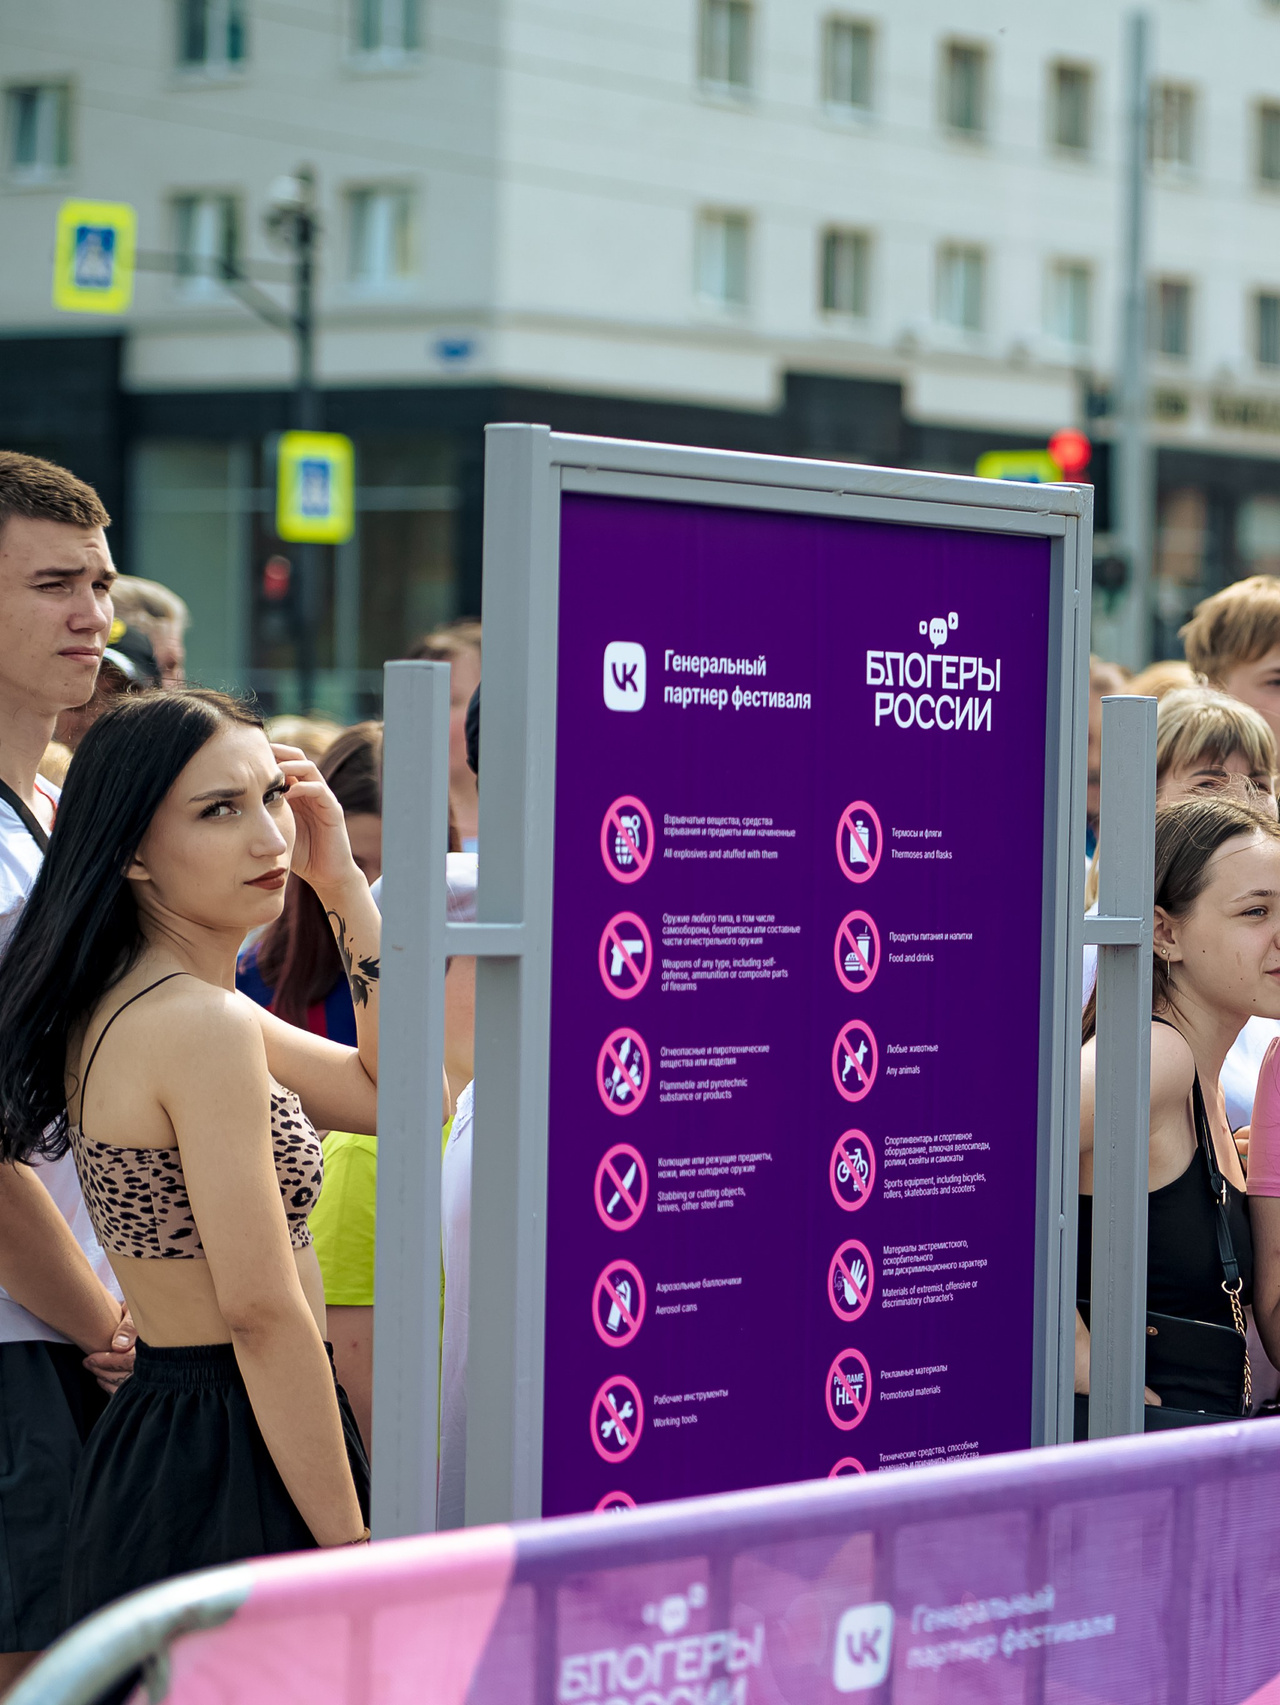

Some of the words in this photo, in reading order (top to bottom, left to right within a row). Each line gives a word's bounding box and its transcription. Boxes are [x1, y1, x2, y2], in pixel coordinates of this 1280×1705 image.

[664, 649, 767, 678] Генеральный
[867, 650, 1001, 692] БЛОГЕРЫ
[664, 685, 727, 710] партнер
[732, 686, 811, 711] фестиваля
[874, 692, 991, 731] РОССИИ
[664, 814, 705, 825] Взрывчатые
[742, 817, 772, 826] средства
[708, 828, 741, 838] предметы
[892, 827, 918, 839] Термосы
[925, 829, 942, 839] фляги
[664, 848, 672, 858] All
[674, 849, 707, 860] explosives
[709, 850, 721, 858] and
[747, 850, 760, 858] with
[762, 850, 778, 859] them
[892, 849, 923, 858] Thermoses
[924, 850, 935, 859] and
[936, 850, 952, 859] flasks
[663, 913, 690, 925] Оружие
[691, 914, 716, 923] любого
[742, 915, 754, 923] том
[756, 915, 775, 923] числе
[712, 925, 752, 935] боеприпасы
[662, 938, 682, 946] части
[683, 937, 736, 947] огнестрельного
[738, 937, 763, 946] оружия
[890, 932, 919, 943] Продукты
[889, 953, 903, 962] Food
[904, 953, 915, 962] and
[916, 953, 934, 962] drinks
[662, 959, 692, 970] Weapons
[693, 958, 700, 968] of
[702, 959, 713, 969] any
[733, 958, 761, 968] including
[692, 970, 728, 979] ammunition
[738, 969, 770, 980] composite
[772, 969, 788, 979] parts
[662, 982, 669, 991] of
[670, 982, 697, 990] firearms
[661, 1046, 705, 1057] Огнеопасные
[707, 1047, 712, 1055] и
[713, 1045, 769, 1056] пиротехнические
[887, 1044, 907, 1054] Любые
[660, 1059, 693, 1069] вещества
[695, 1058, 707, 1066] или
[709, 1057, 736, 1066] изделия
[886, 1066, 897, 1077] Any
[898, 1065, 920, 1074] animals
[697, 1080, 709, 1089] and
[710, 1078, 748, 1090] pyrotechnic
[695, 1092, 702, 1100] or
[703, 1091, 732, 1102] products
[885, 1136, 933, 1146] Спортинвентарь
[939, 1133, 972, 1143] спортивное
[658, 1158, 690, 1167] Колющие
[692, 1157, 704, 1165] или
[706, 1155, 736, 1166] режущие
[909, 1156, 929, 1165] скейты
[935, 1155, 963, 1163] самокаты
[680, 1169, 695, 1177] иное
[698, 1167, 729, 1176] холодное
[730, 1165, 756, 1175] оружие
[884, 1179, 903, 1189] Sports
[904, 1177, 935, 1187] equipment,
[936, 1174, 961, 1184] including
[963, 1173, 986, 1182] bicycles,
[658, 1191, 687, 1201] Stabbing
[688, 1191, 695, 1199] or
[697, 1189, 719, 1199] cutting
[721, 1187, 746, 1197] objects,
[884, 1190, 902, 1199] rollers,
[904, 1187, 939, 1197] skateboards
[940, 1186, 950, 1194] and
[952, 1185, 975, 1193] scooters
[657, 1203, 680, 1212] knives,
[682, 1202, 699, 1211] other
[701, 1200, 716, 1209] steel
[718, 1200, 733, 1208] arms
[883, 1245, 917, 1255] Материалы
[883, 1254, 933, 1266] оскорбительного
[895, 1263, 957, 1276] дискриминационного
[959, 1259, 987, 1270] характера
[656, 1281, 701, 1293] Аэрозольные
[702, 1277, 742, 1288] баллончики
[882, 1287, 908, 1297] Materials
[909, 1285, 916, 1294] of
[917, 1283, 944, 1294] extremist,
[946, 1281, 971, 1291] offensive
[882, 1296, 922, 1308] discriminatory
[655, 1304, 680, 1315] Aerosol
[682, 1304, 697, 1312] cans
[881, 1369, 914, 1379] Рекламные
[915, 1365, 948, 1375] материалы
[834, 1373, 864, 1385] РЛАМЕ
[654, 1394, 682, 1405] Рабочие
[684, 1389, 728, 1401] инструменты
[880, 1389, 914, 1400] Promotional
[915, 1385, 941, 1395] materials
[653, 1417, 680, 1428] Working
[682, 1414, 697, 1424] tools
[879, 1451, 916, 1462] Технические
[948, 1441, 979, 1452] способные
[559, 1624, 765, 1699] БЛОГЕРЫ
